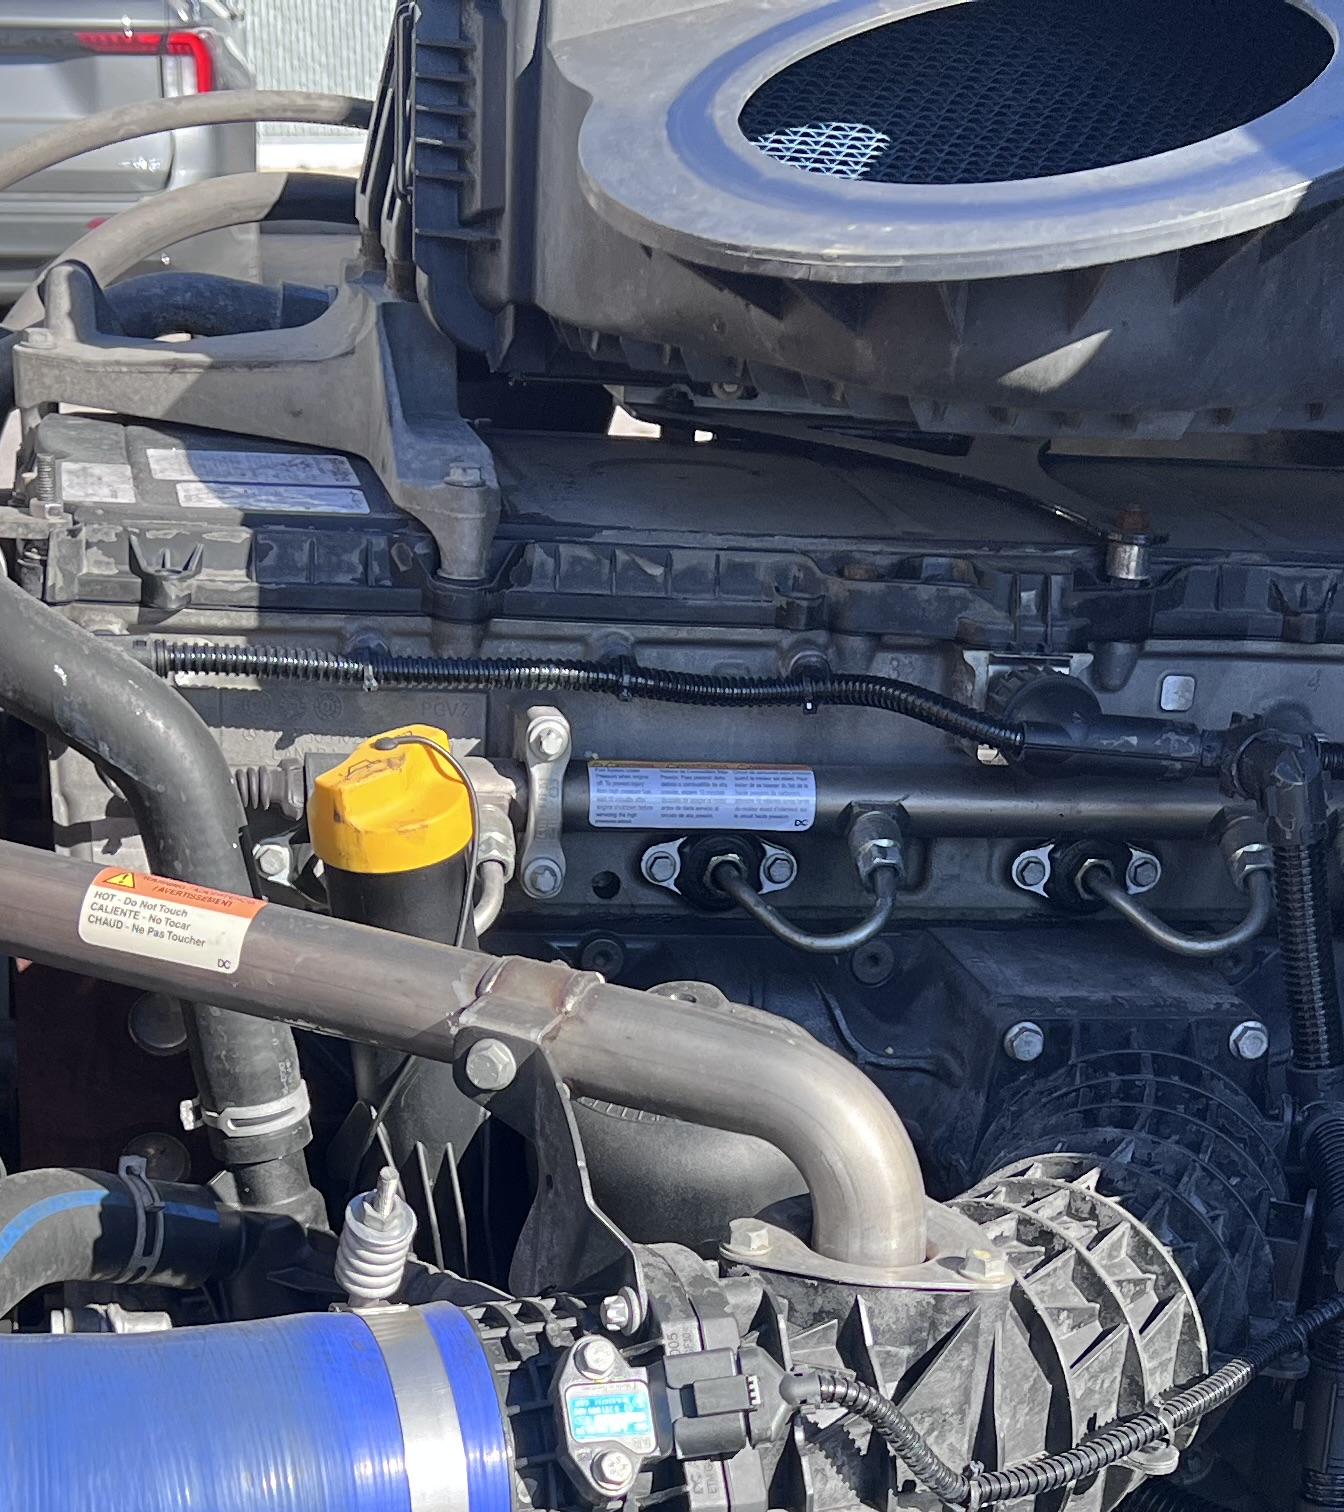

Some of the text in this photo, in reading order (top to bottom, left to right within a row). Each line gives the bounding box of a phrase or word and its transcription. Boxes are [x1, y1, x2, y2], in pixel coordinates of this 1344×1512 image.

[94, 891, 114, 902] HOT
[124, 897, 137, 906] Do
[139, 901, 156, 911] Not
[159, 905, 188, 918] Touch
[158, 888, 233, 908] AVERTISSEMENT
[88, 914, 123, 930] CHAUD
[132, 922, 145, 935] Ne
[147, 927, 164, 939] Pas
[167, 930, 206, 947] Toucher
[90, 903, 140, 920] CALIENTE
[148, 914, 162, 924] No
[164, 917, 191, 931] Tocar
[217, 958, 231, 970] DC
